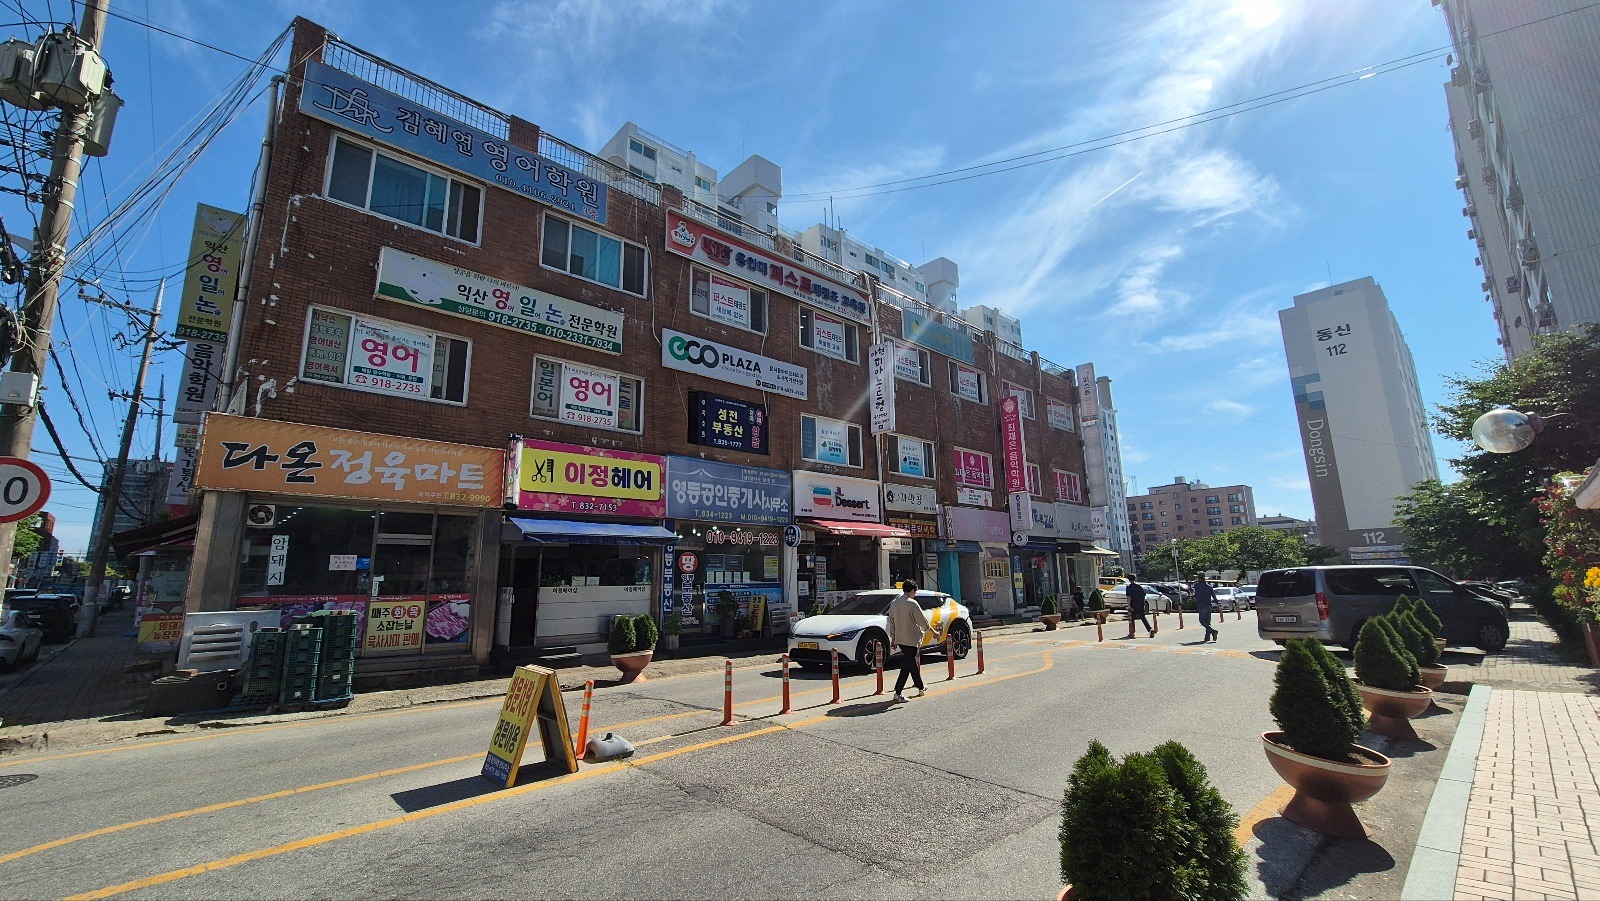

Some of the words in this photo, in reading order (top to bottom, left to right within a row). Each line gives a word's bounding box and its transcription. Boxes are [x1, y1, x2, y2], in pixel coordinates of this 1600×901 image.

[397, 106, 475, 156] 김혜연
[482, 140, 599, 210] 영어학원
[457, 284, 488, 305] 익산
[568, 314, 618, 339] 전문학원
[178, 327, 227, 342] 918-2735
[458, 304, 486, 319] 상담문의
[488, 312, 537, 332] 918-2735
[545, 325, 613, 350] 010-2331-7934
[1316, 323, 1352, 342] 동신
[361, 338, 420, 373] 영어
[1326, 344, 1348, 357] 112
[722, 352, 762, 374] PLAZA
[185, 343, 214, 403] 음악학원
[371, 378, 421, 393] 918-2735
[537, 362, 555, 408] 일본어
[569, 376, 612, 407] 영어
[578, 414, 612, 426] 918-2735
[712, 421, 744, 438] 부동산
[1306, 417, 1332, 478] Dongsin
[220, 440, 323, 484] 다온
[329, 449, 485, 490] 정육마트
[564, 461, 652, 491] 이정헤어
[0, 476, 29, 505] 0
[443, 491, 491, 503] T.832-9990
[672, 479, 789, 513] 영등공인중개사사무소
[571, 501, 618, 512] T.832-7153
[835, 496, 871, 510] Dessert
[695, 509, 733, 519] T.834-1223
[741, 514, 789, 524] M.010-9419-1223
[706, 529, 779, 546] 010-9419-1223
[1362, 531, 1387, 544] 112
[268, 537, 288, 584] 암돼지
[681, 555, 696, 571] 땅
[371, 607, 391, 620] 매주
[393, 606, 405, 619] 화
[409, 606, 421, 619] 목
[376, 620, 414, 631] 소잡는날
[368, 634, 400, 649] 육사시미
[402, 633, 420, 647] 판매
